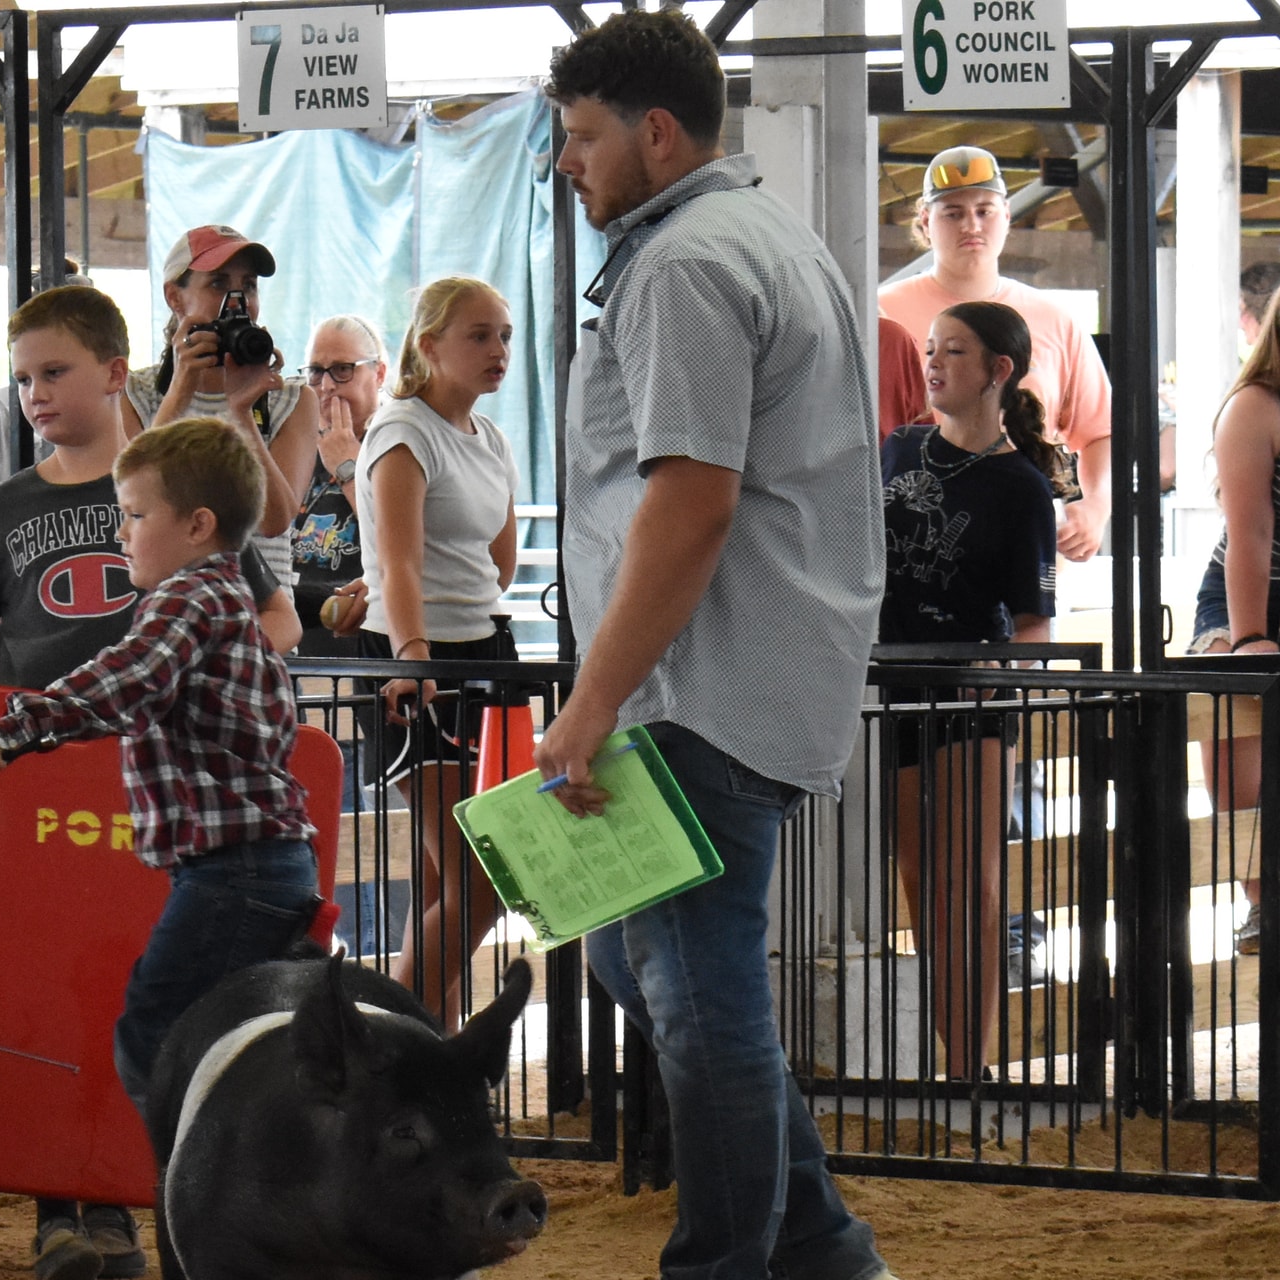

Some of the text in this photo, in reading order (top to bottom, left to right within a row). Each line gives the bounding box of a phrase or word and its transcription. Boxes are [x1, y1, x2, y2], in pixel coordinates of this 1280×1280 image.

[973, 0, 1035, 22] PORK
[301, 22, 359, 45] Da Ja
[955, 31, 1056, 53] COUNCIL
[913, 0, 948, 95] 6
[250, 24, 282, 116] 7
[303, 54, 358, 77] VIEW
[962, 62, 1049, 83] WOMEN
[295, 86, 370, 110] FARMS
